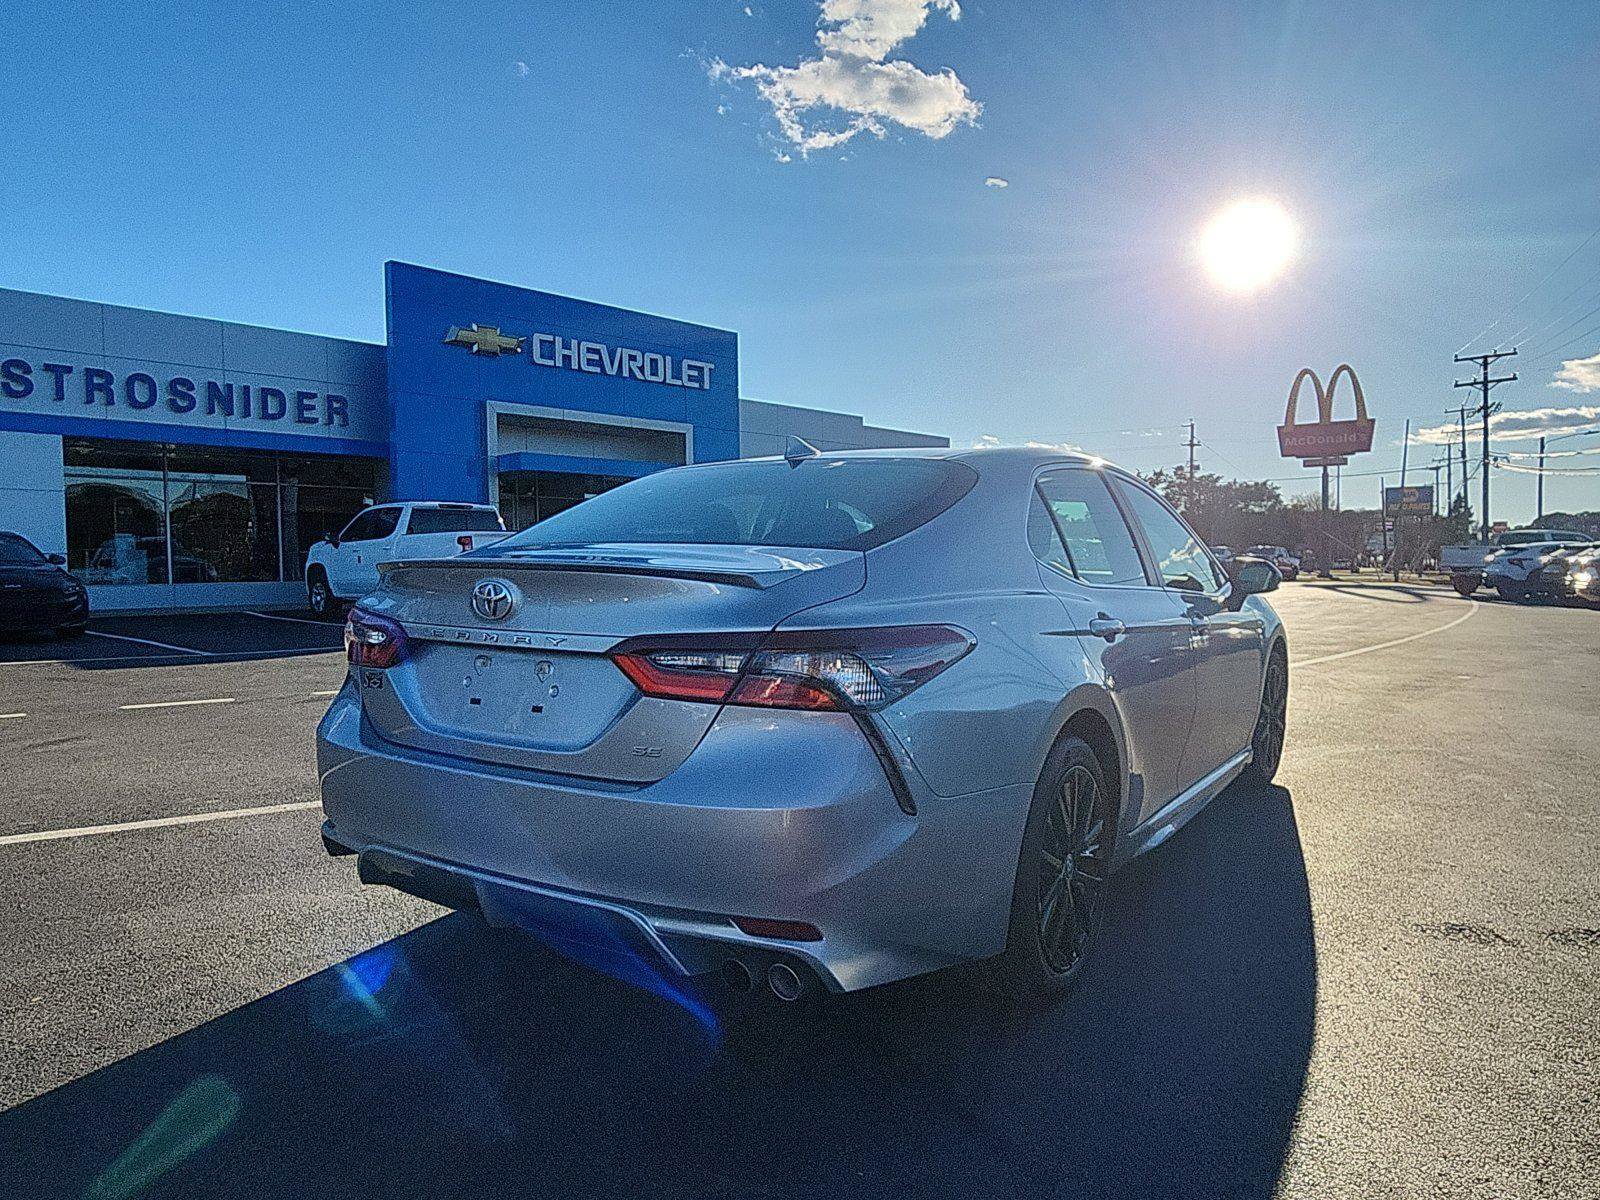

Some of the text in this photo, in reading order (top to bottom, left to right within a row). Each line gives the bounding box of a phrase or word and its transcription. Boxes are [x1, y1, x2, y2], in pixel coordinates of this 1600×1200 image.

[532, 333, 715, 390] CHEVROLET
[0, 358, 349, 427] STROSNIDER
[1284, 432, 1367, 446] McDonald's
